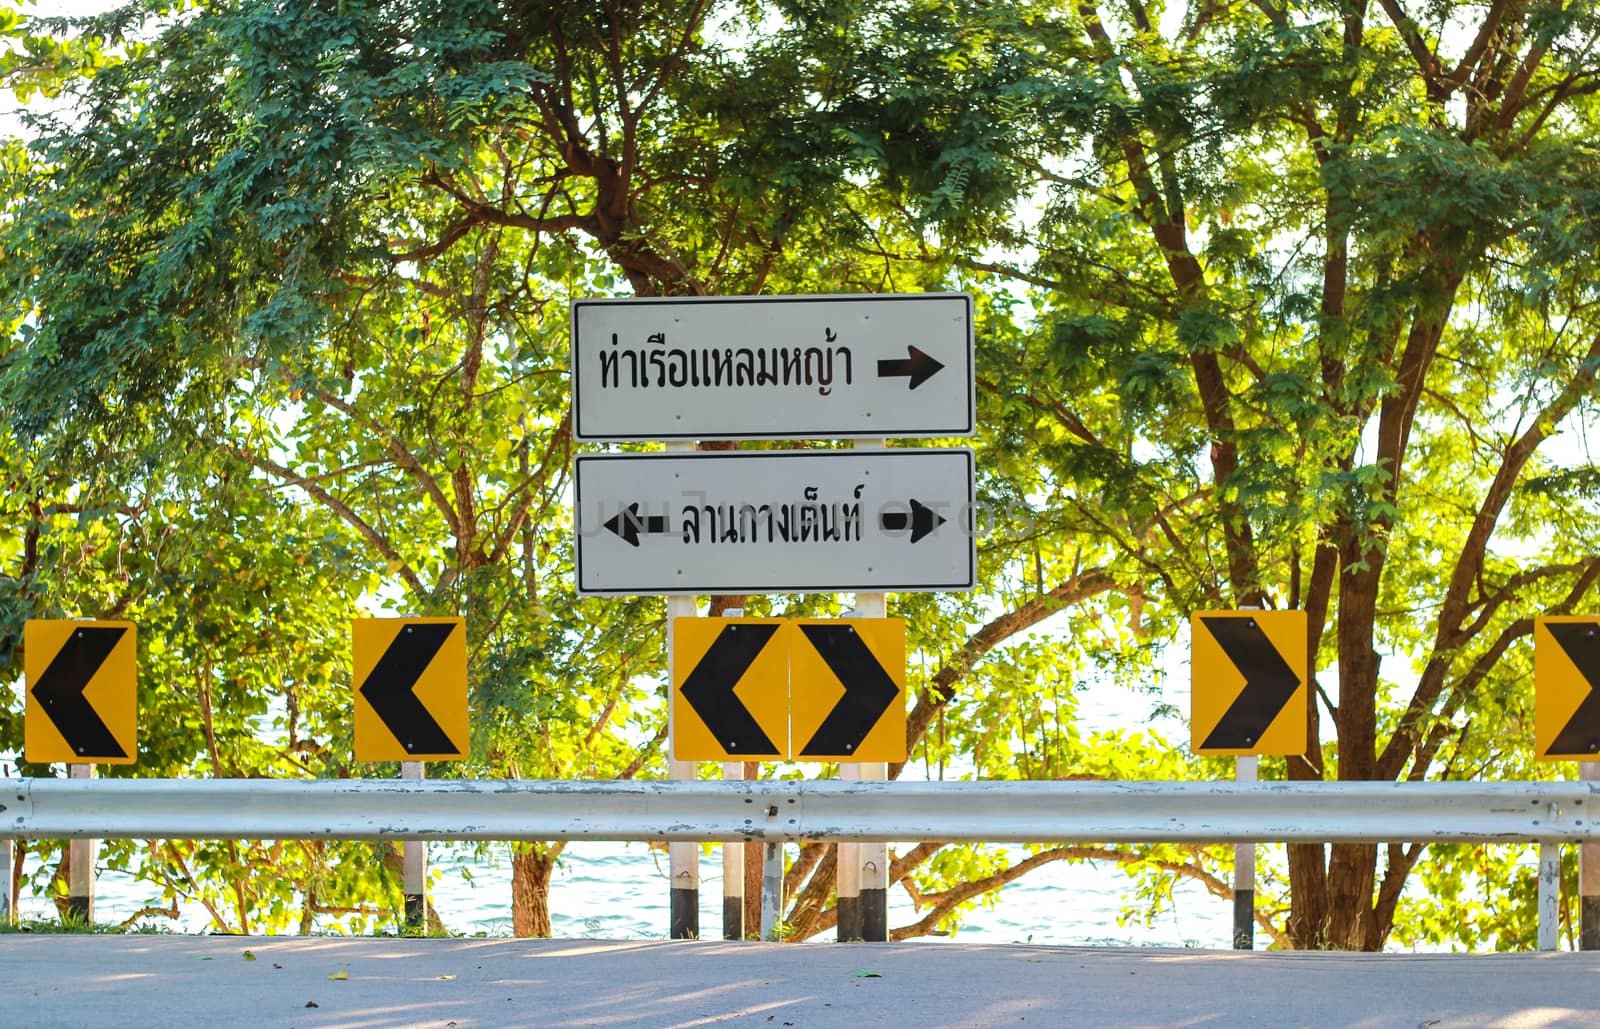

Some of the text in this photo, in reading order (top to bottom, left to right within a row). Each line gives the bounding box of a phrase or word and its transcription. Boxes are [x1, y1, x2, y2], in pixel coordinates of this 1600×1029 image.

[599, 327, 852, 396] ท่าเรือแหลมหญ้า
[681, 483, 865, 544] ลานกางเต็นท์
